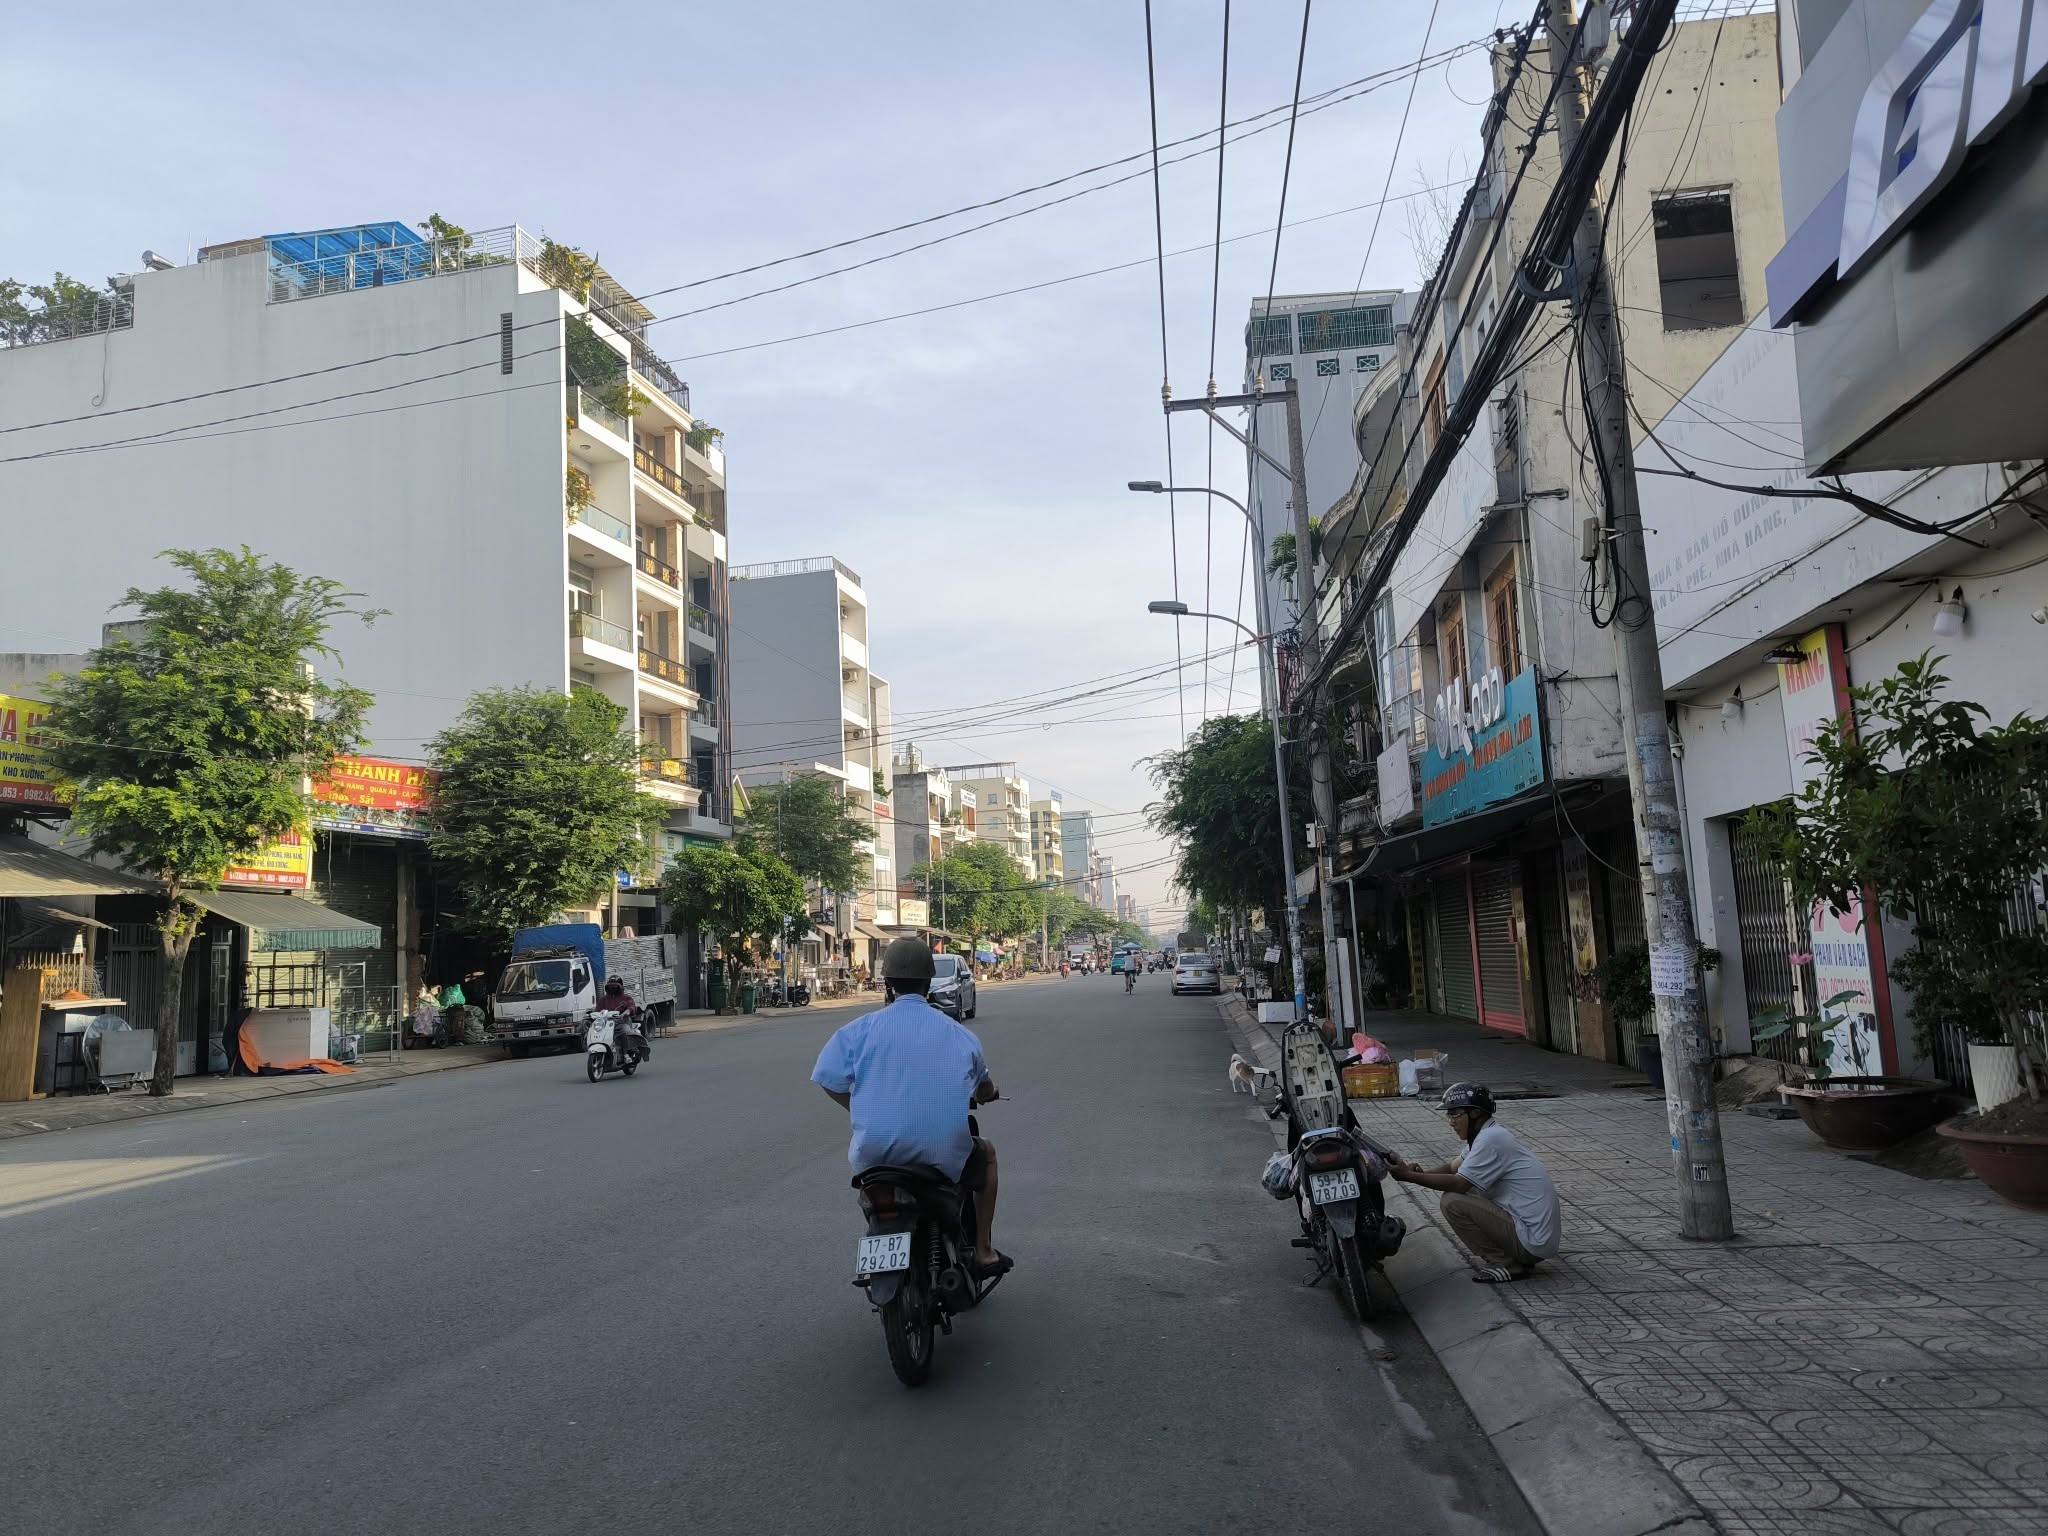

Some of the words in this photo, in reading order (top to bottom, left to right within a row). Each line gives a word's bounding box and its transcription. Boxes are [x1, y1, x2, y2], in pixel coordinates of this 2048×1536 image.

[3, 766, 18, 777] KHO
[1315, 1184, 1357, 1201] 787.09
[860, 1252, 907, 1272] 292.02
